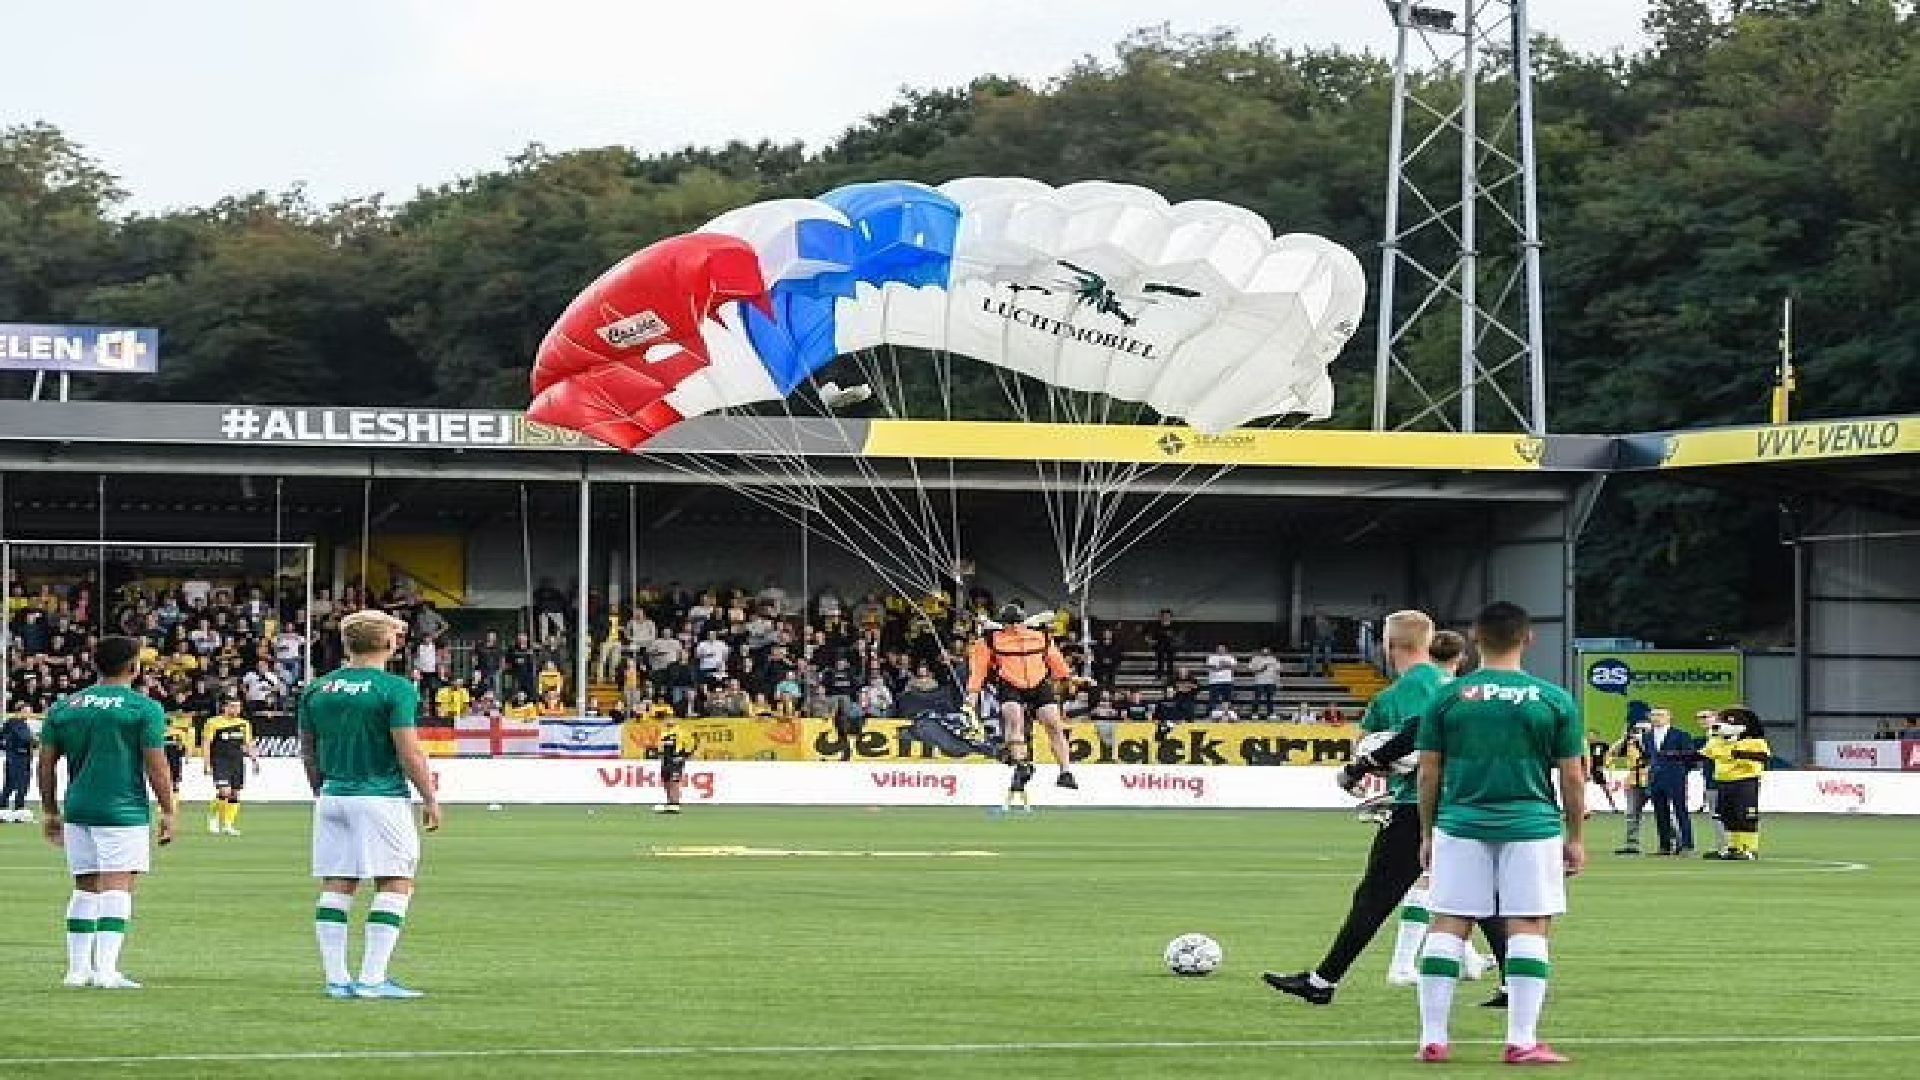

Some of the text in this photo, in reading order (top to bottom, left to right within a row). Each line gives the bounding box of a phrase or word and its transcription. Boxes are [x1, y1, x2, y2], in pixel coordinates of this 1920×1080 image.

[983, 297, 1157, 360] LUCHTMOBIEL
[1756, 421, 1899, 457] VVV-VENLO
[1592, 667, 1628, 684] as
[1484, 684, 1540, 704] Payt
[870, 770, 957, 796] Viking
[1121, 773, 1204, 798] Viking
[1816, 779, 1866, 804] Viking
